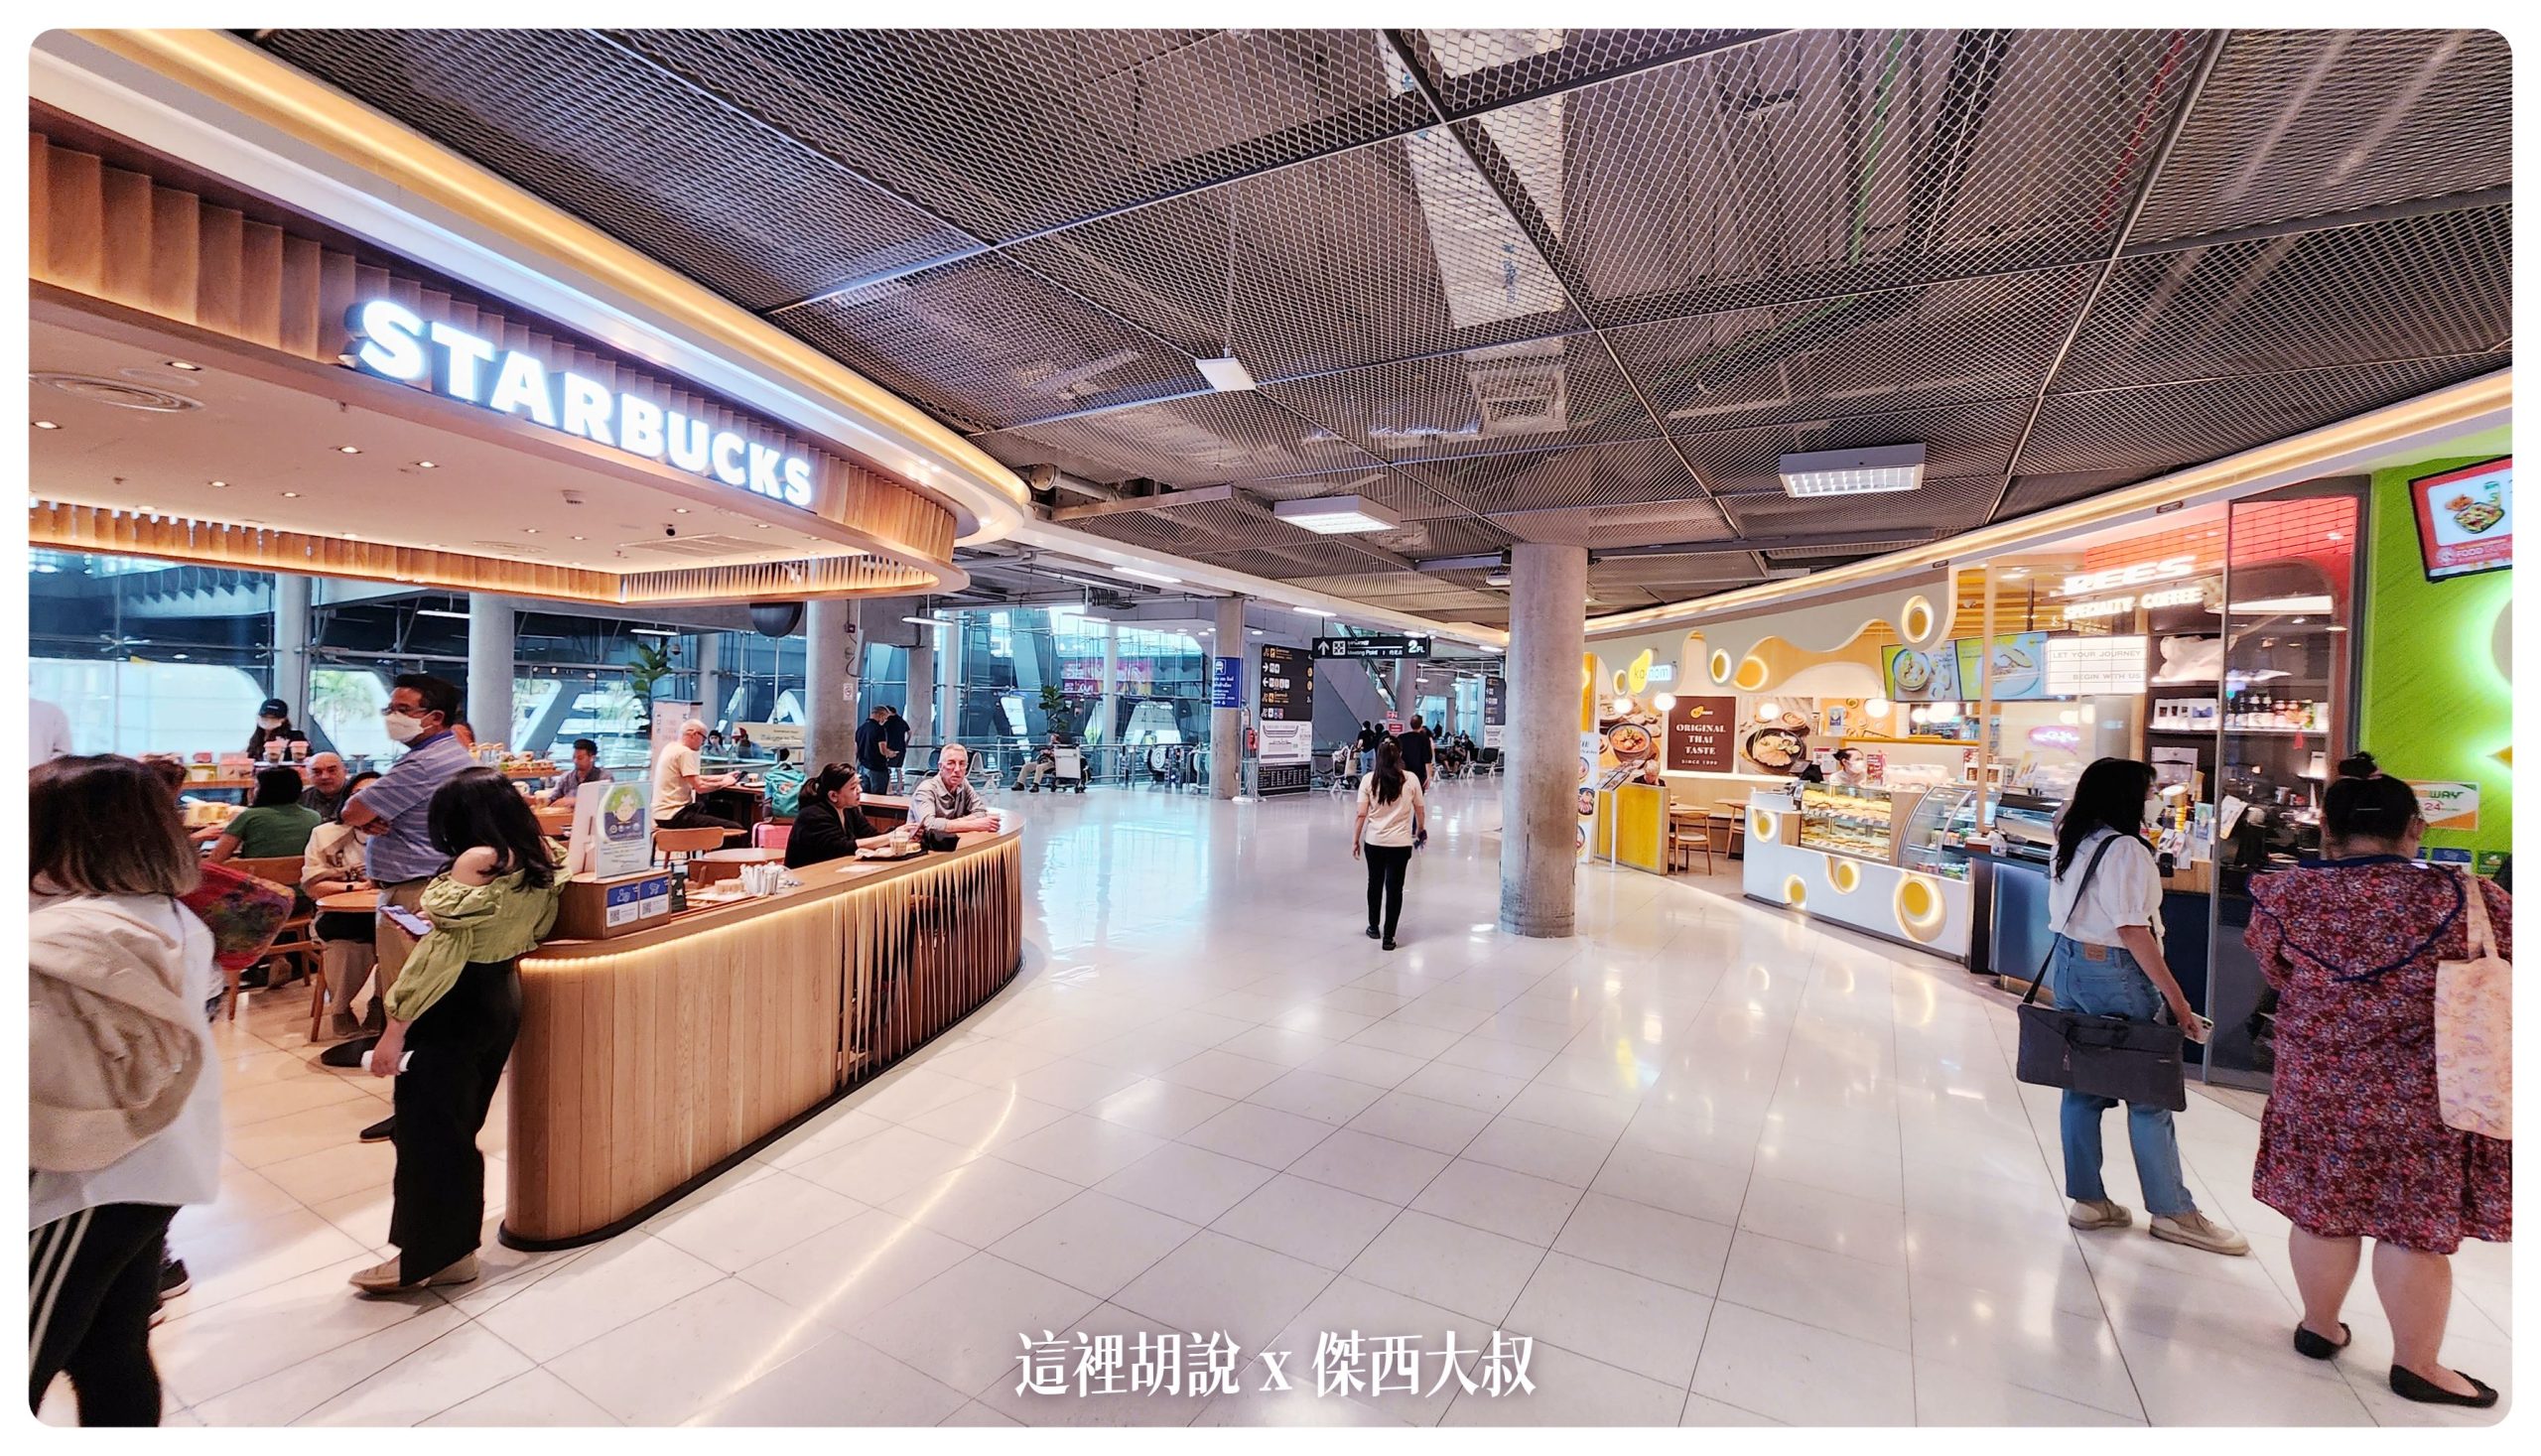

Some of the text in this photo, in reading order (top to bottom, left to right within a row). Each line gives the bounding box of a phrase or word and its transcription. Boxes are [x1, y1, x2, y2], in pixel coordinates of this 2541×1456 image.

[357, 299, 815, 506] STARBUCKS
[2141, 587, 2204, 608] COFFEE
[1675, 724, 1726, 732] ORIGINAL
[1687, 734, 1713, 743] THAI
